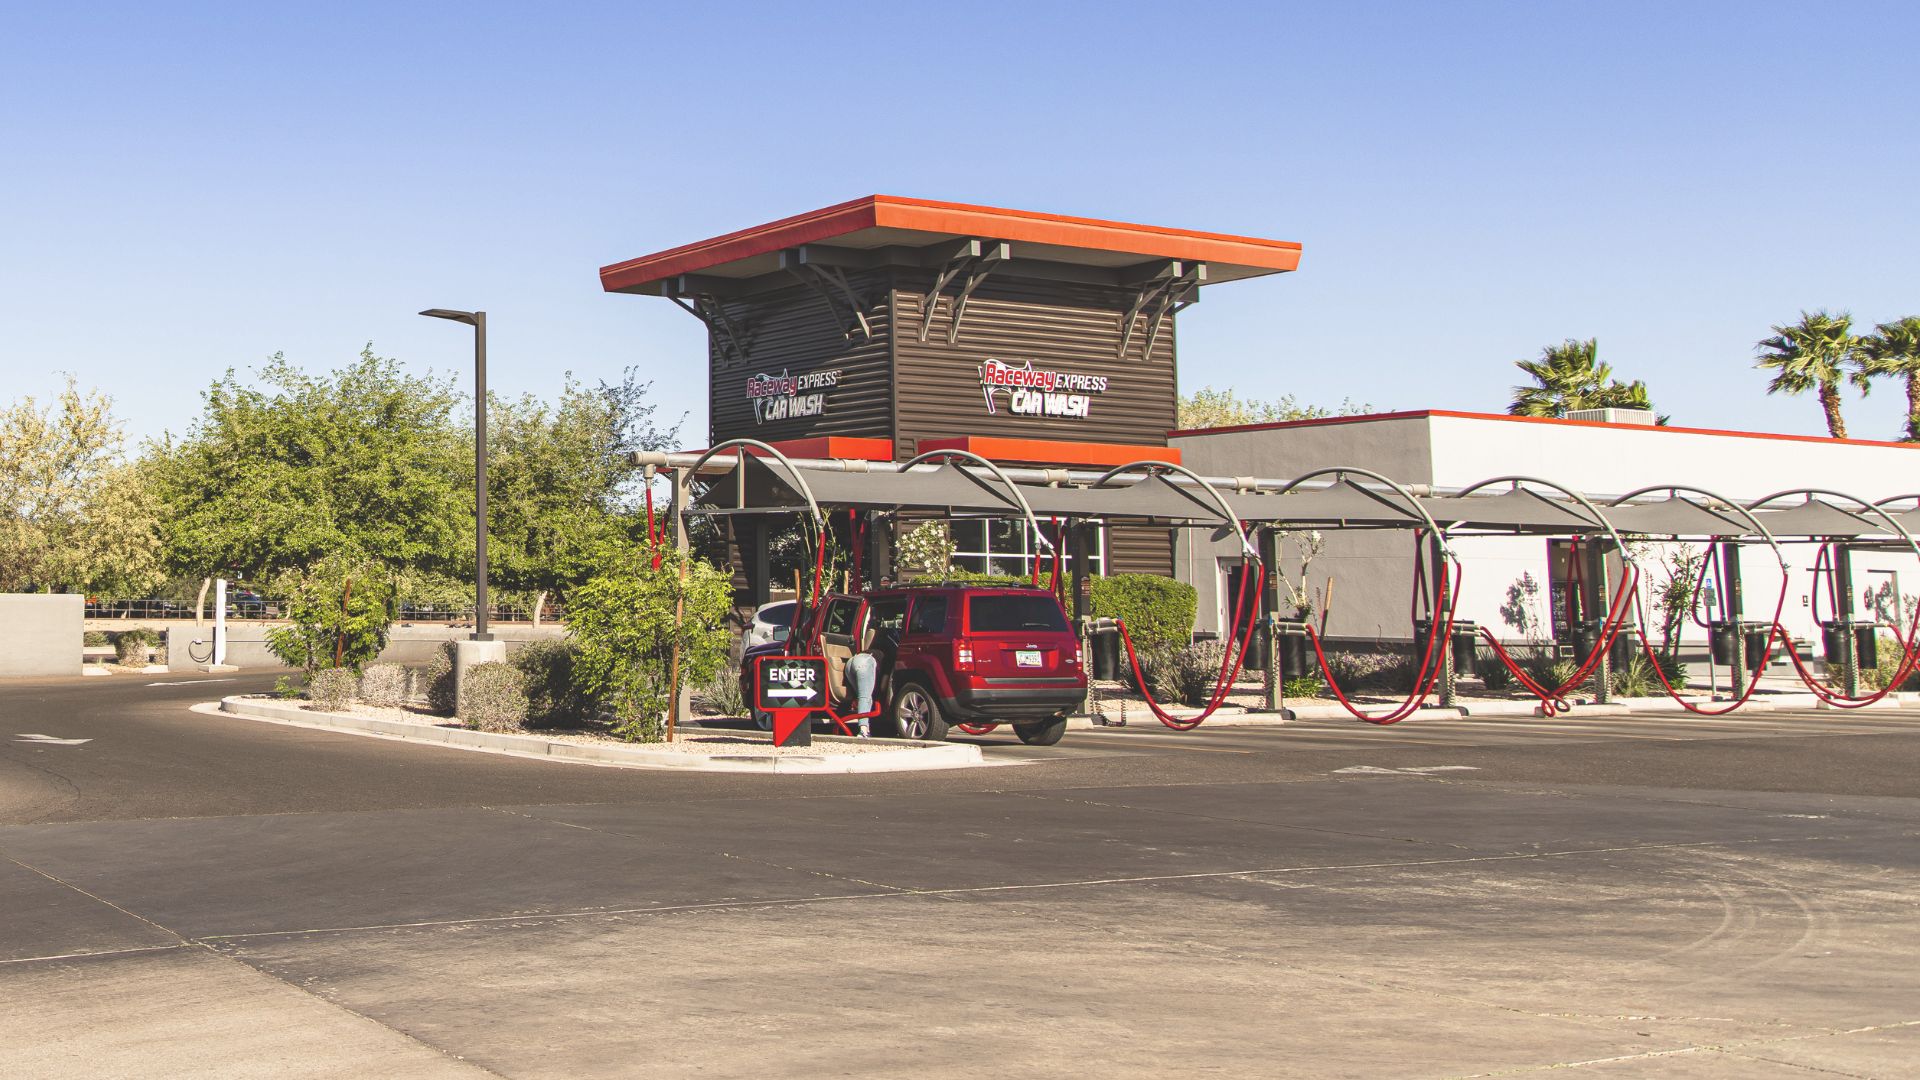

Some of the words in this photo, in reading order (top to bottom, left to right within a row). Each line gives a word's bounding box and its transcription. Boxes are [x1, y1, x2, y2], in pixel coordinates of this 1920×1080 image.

[746, 376, 798, 398] Raceway
[797, 371, 837, 390] EXPRESS
[984, 363, 1056, 392] Raceway
[1055, 373, 1107, 391] EXPRESS
[765, 398, 788, 420] CAR
[788, 394, 823, 417] WASH
[1011, 391, 1043, 414] CAR
[1044, 392, 1090, 417] WASH
[769, 668, 816, 681] ENTER
